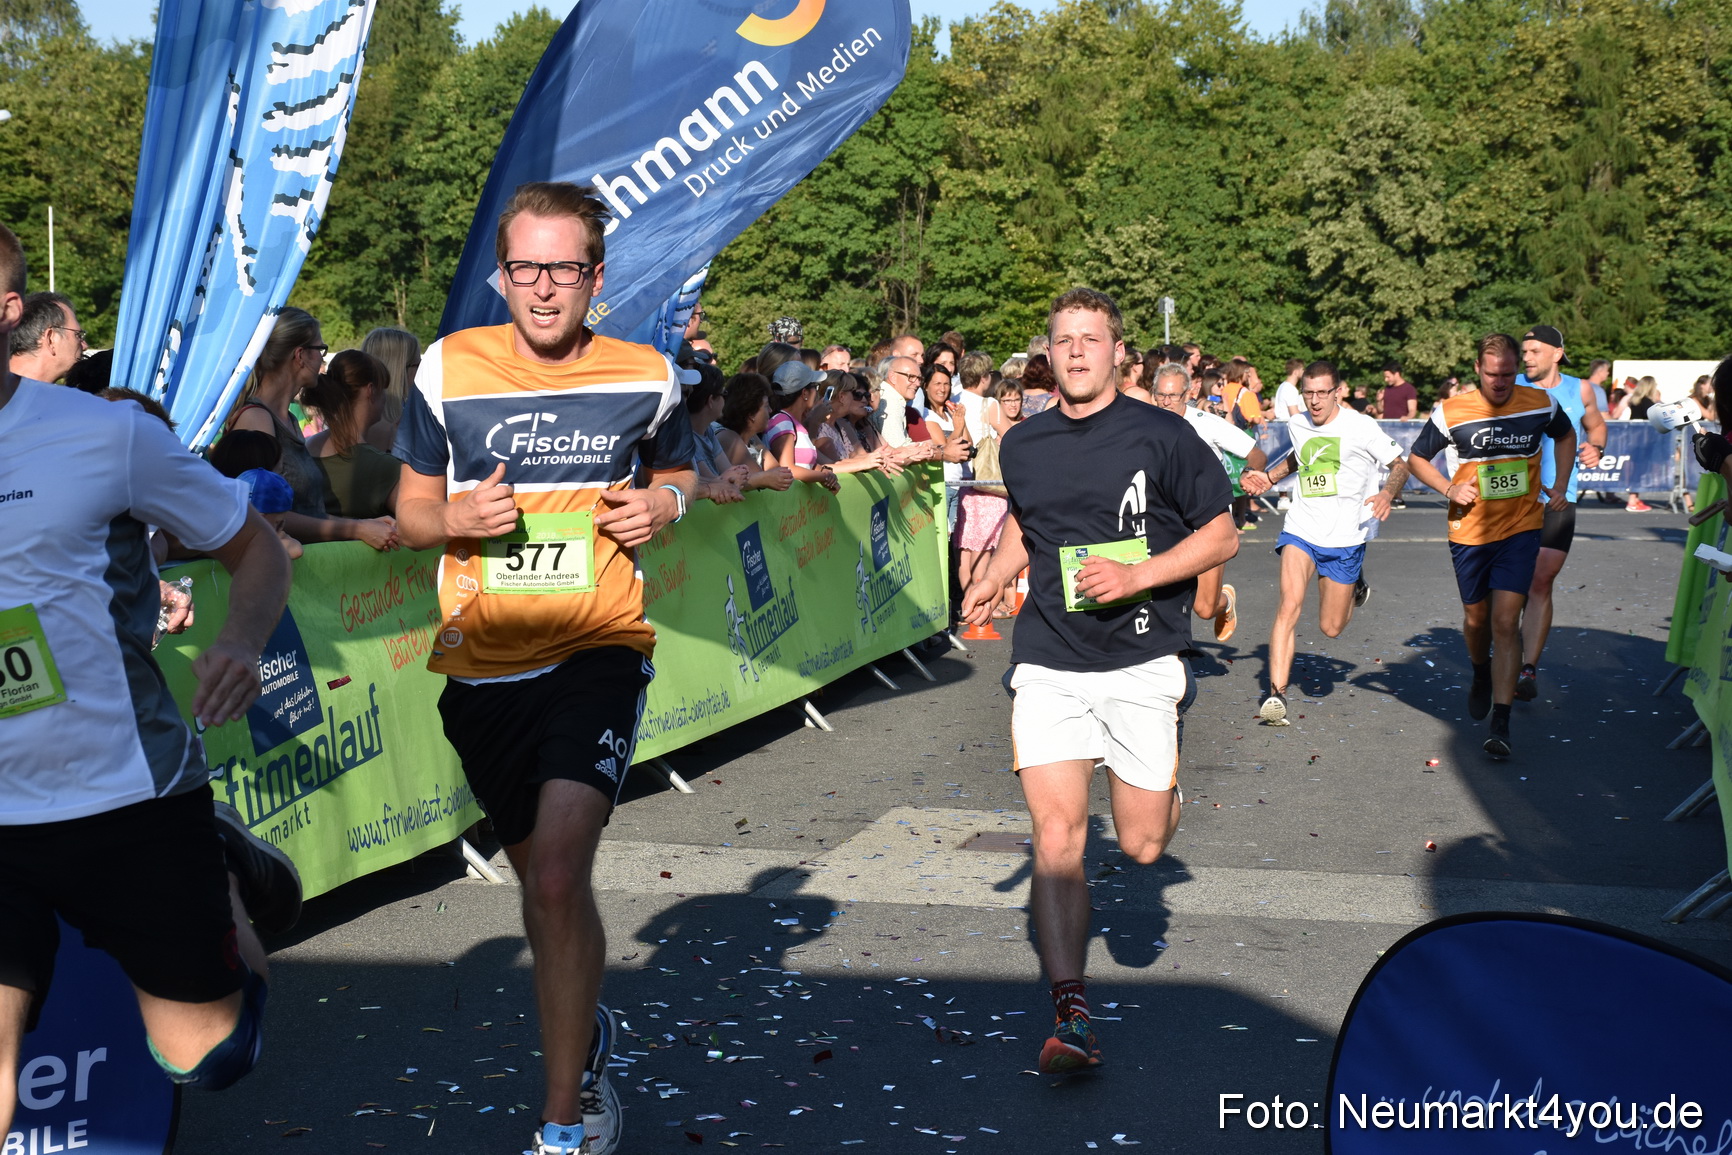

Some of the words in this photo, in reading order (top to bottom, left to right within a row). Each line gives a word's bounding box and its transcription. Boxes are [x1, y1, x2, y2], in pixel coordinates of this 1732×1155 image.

[683, 134, 754, 198] Druck
[753, 92, 801, 139] und
[796, 27, 882, 100] Medien
[510, 429, 620, 454] Fischer
[1482, 434, 1533, 446] Fischer
[521, 454, 611, 466] AUTOMOBILE
[1306, 475, 1327, 488] 149
[1490, 474, 1519, 490] 585
[505, 543, 567, 572] 577
[746, 550, 762, 569] Fischer
[869, 541, 912, 614] firmenlauf
[341, 565, 404, 632] Gesunde
[744, 575, 799, 661] firmenlauf
[382, 618, 433, 672] laufen
[445, 632, 459, 642] FIAT
[257, 650, 297, 682] ischer
[1, 682, 40, 698] Florian
[261, 670, 299, 696] AUTOMOBILE
[225, 682, 384, 829] firmenlauf
[595, 763, 618, 784] adidas
